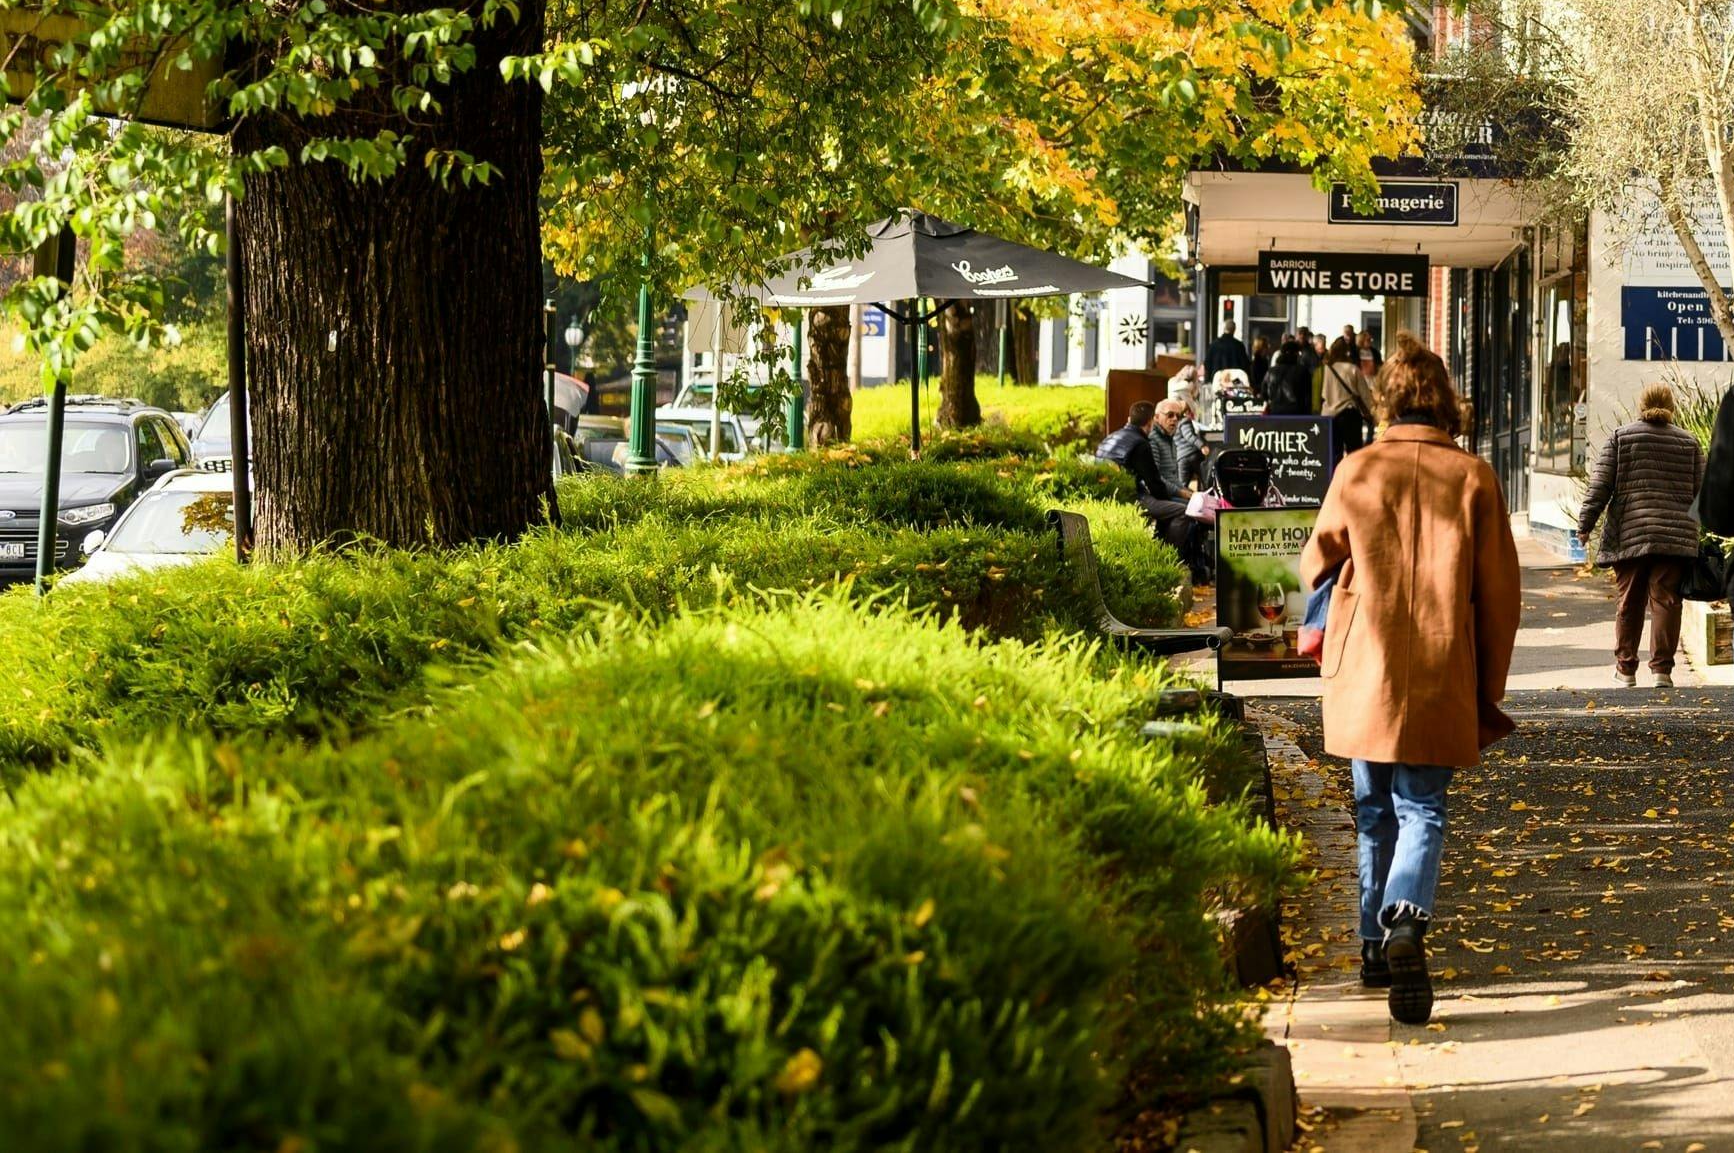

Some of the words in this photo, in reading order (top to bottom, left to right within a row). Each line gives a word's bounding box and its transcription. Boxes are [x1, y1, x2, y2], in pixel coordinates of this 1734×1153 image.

[1342, 194, 1444, 212] Fmagerie
[1270, 259, 1317, 270] BARRIQUE
[1270, 271, 1331, 289] WINE
[1340, 271, 1414, 291] STORE
[1667, 301, 1704, 314] Open
[1239, 427, 1314, 455] MOTHER
[1228, 528, 1278, 543] HAPPY
[1281, 527, 1314, 541] HOU
